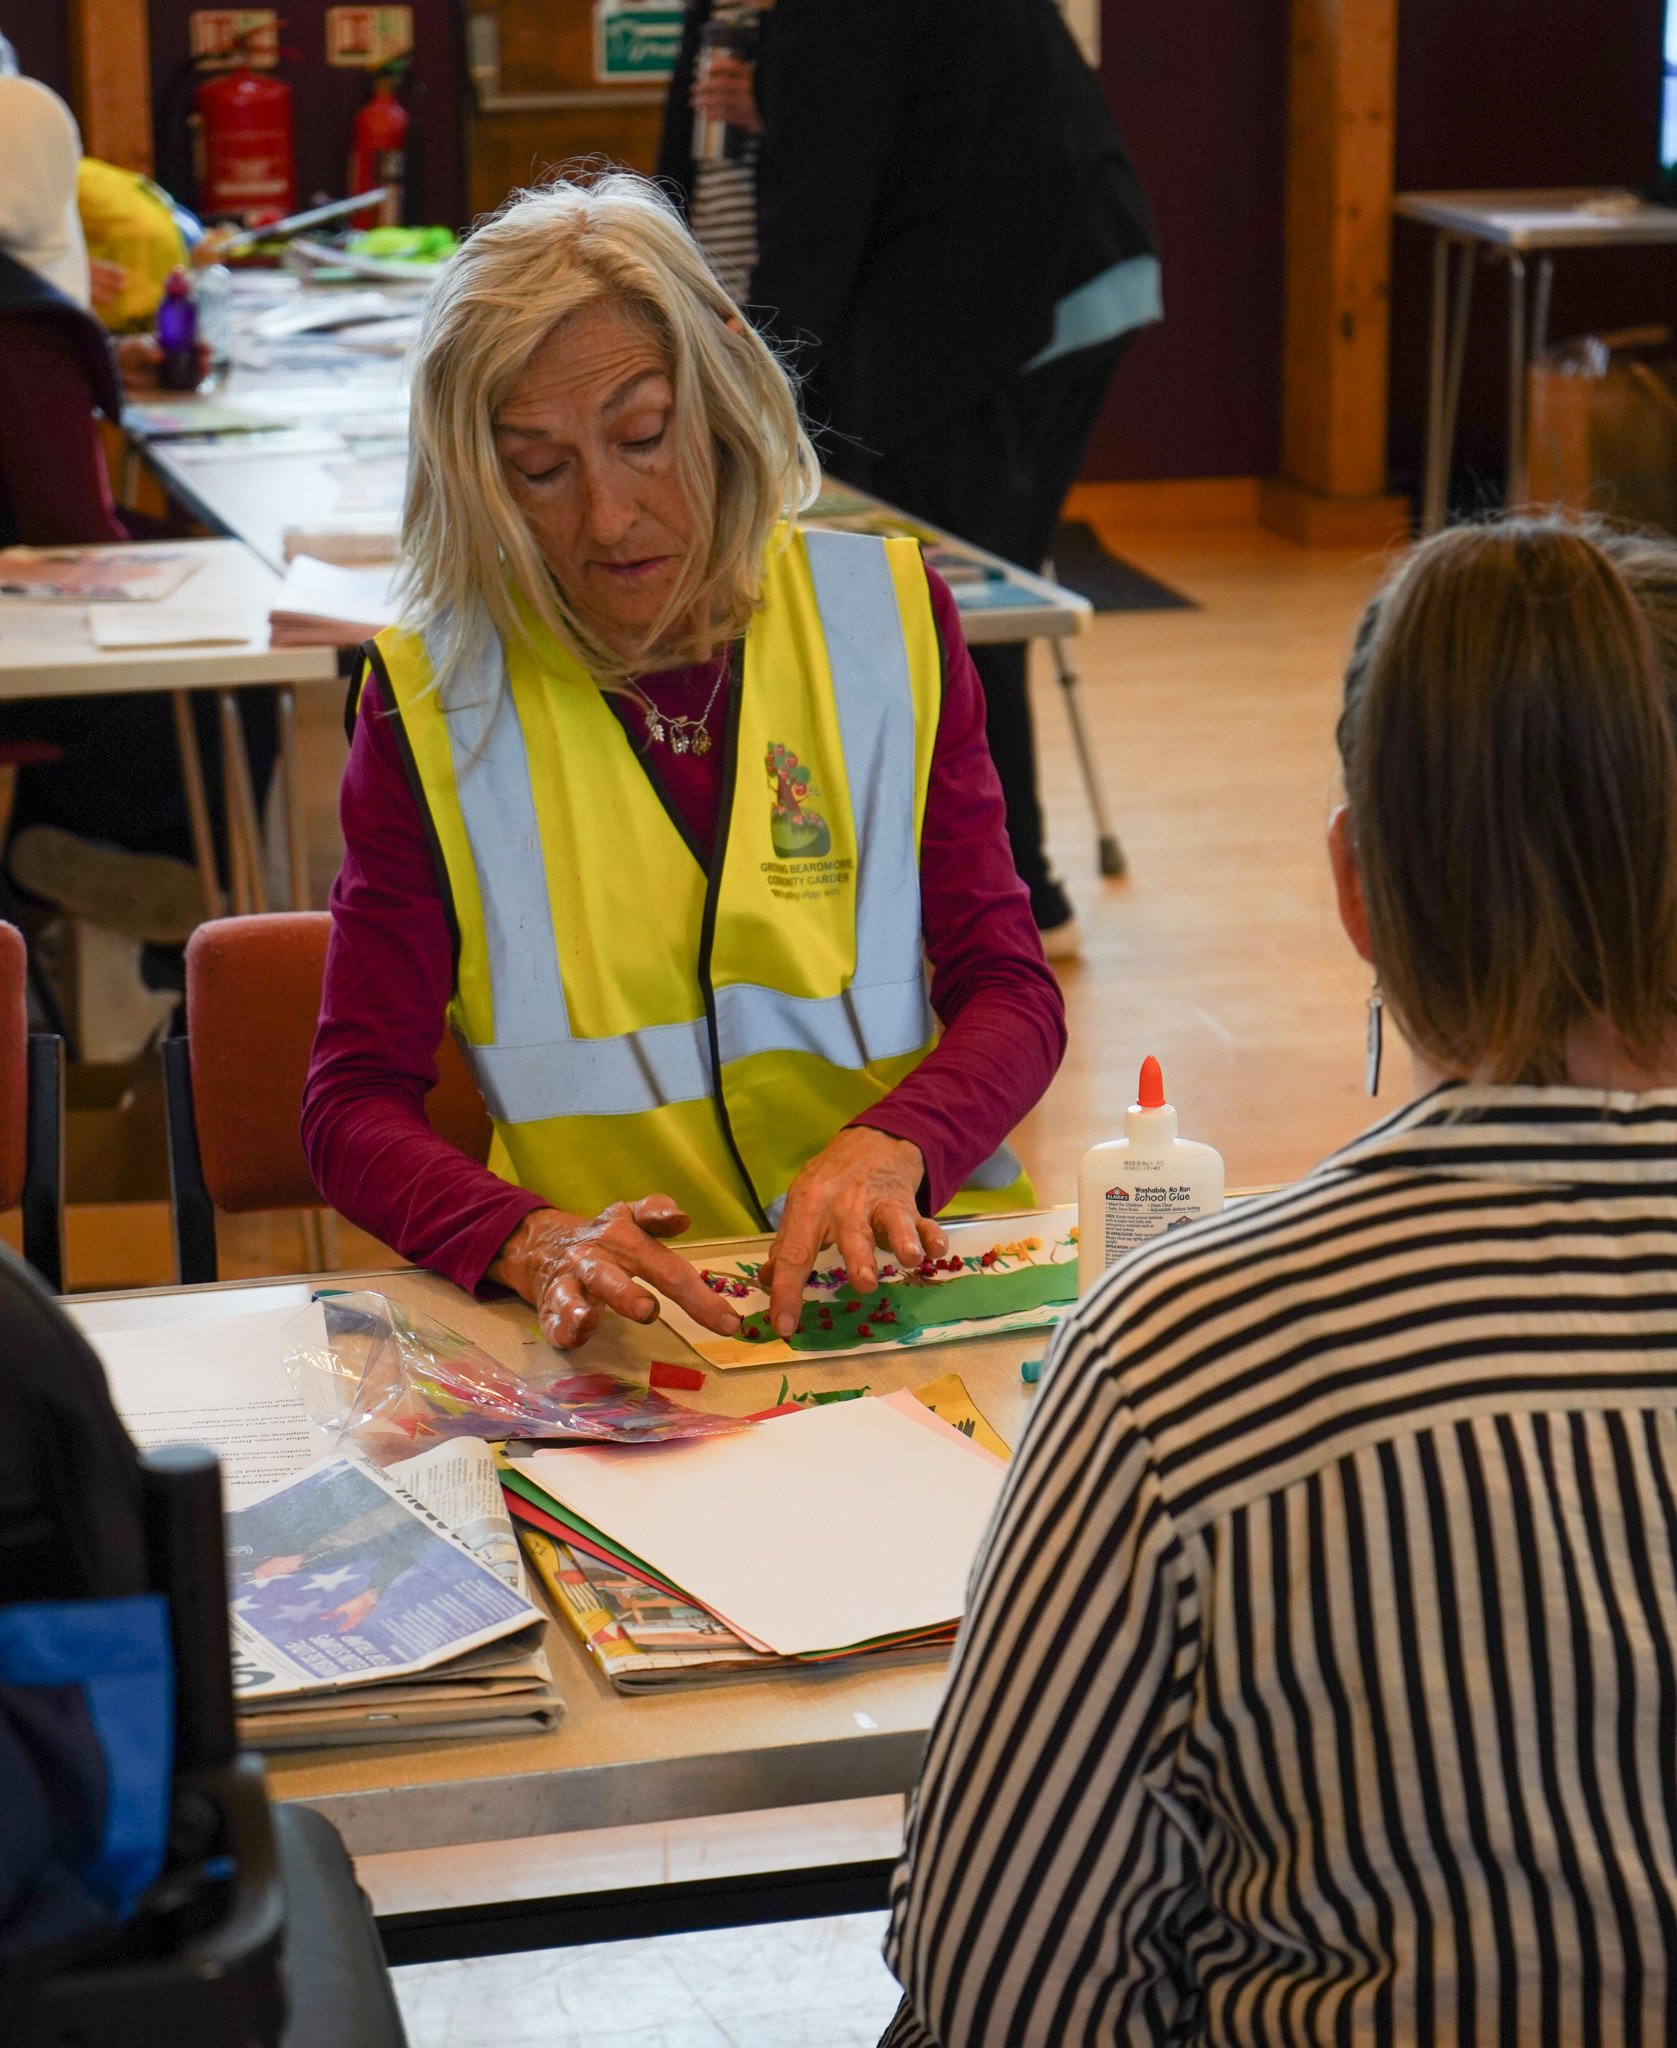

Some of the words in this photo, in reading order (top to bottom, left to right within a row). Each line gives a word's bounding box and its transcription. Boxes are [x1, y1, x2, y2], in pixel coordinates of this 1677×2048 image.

[789, 859, 852, 874] BEARDMORE
[807, 872, 850, 885] GARDEN
[1134, 1193, 1166, 1202] School
[1168, 1193, 1190, 1202] Glue
